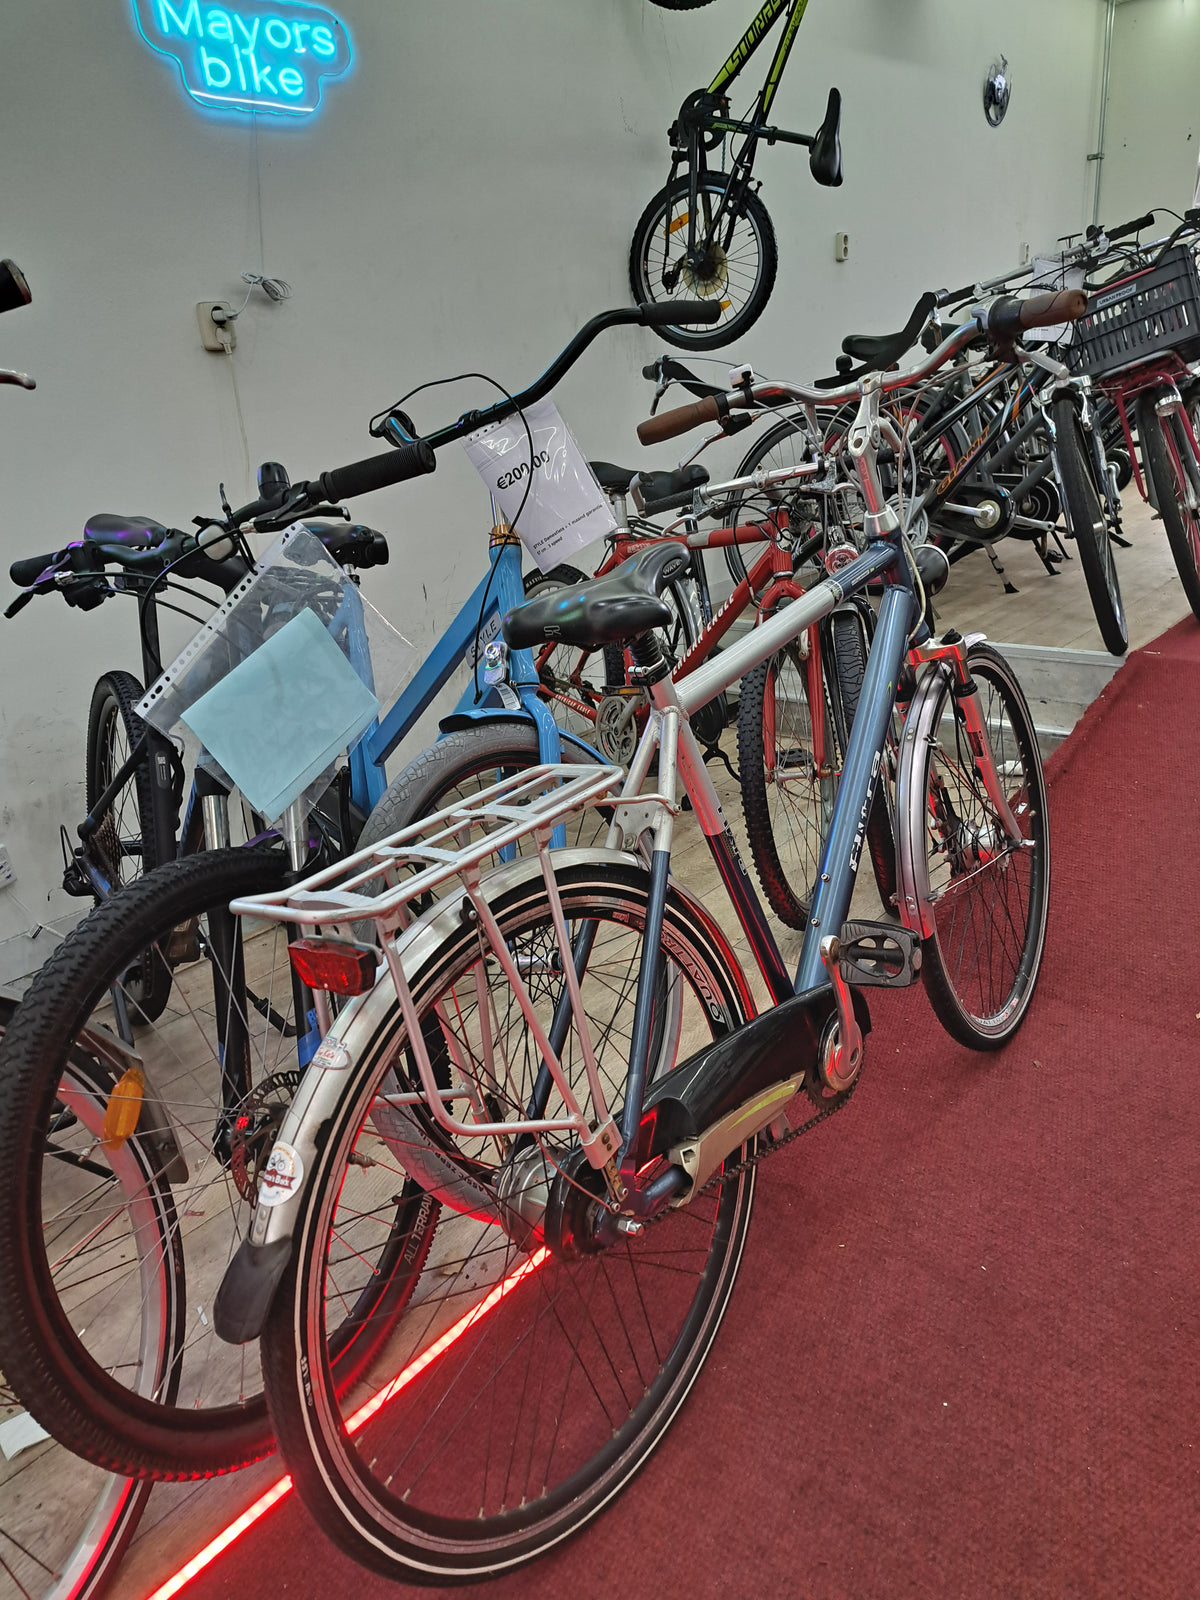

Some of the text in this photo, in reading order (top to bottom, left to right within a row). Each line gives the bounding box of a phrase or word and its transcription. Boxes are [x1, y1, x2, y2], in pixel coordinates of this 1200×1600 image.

[157, 0, 336, 55] Mayors
[200, 43, 304, 96] bike
[936, 425, 990, 495] GIANT
[662, 558, 683, 575] WAVE
[706, 593, 735, 632] EAGLE
[470, 619, 497, 659] SYLE
[554, 693, 591, 715] AMERICAN EAGLE
[403, 1238, 420, 1266] ALL
